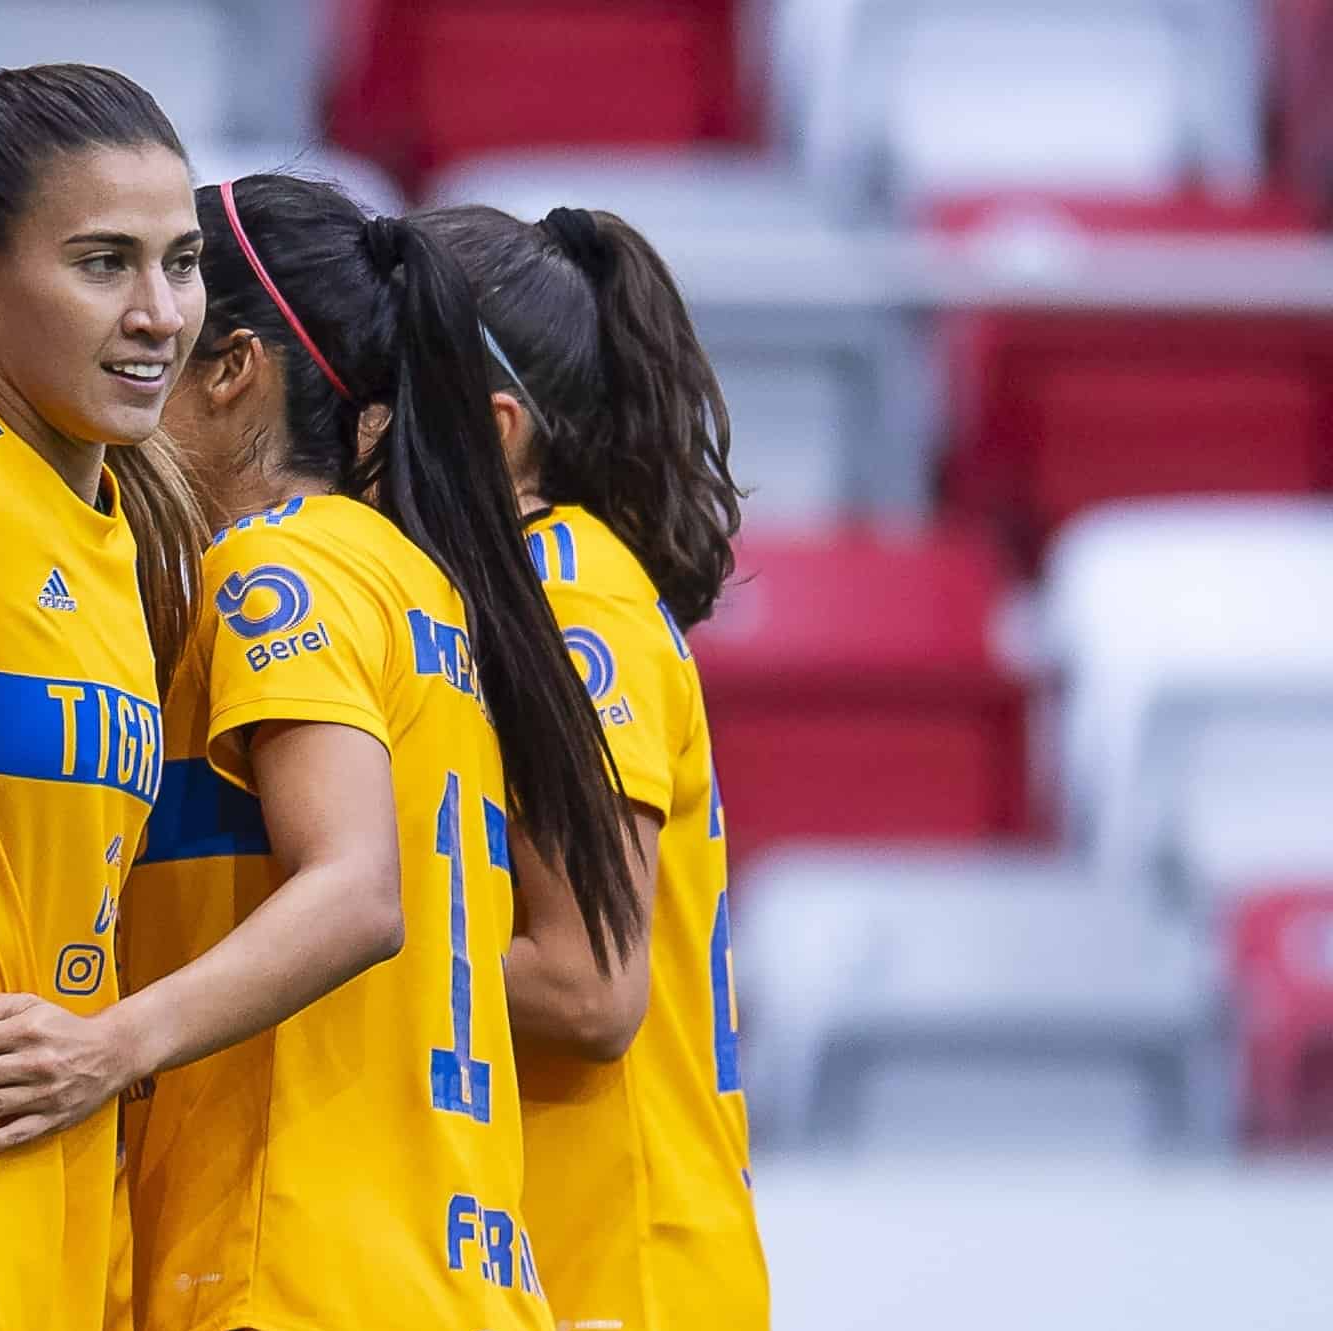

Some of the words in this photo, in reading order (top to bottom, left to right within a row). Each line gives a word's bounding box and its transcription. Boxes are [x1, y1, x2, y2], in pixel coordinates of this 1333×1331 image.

[245, 621, 330, 673] Berel
[596, 695, 633, 728] rel
[46, 684, 163, 803] TIGR
